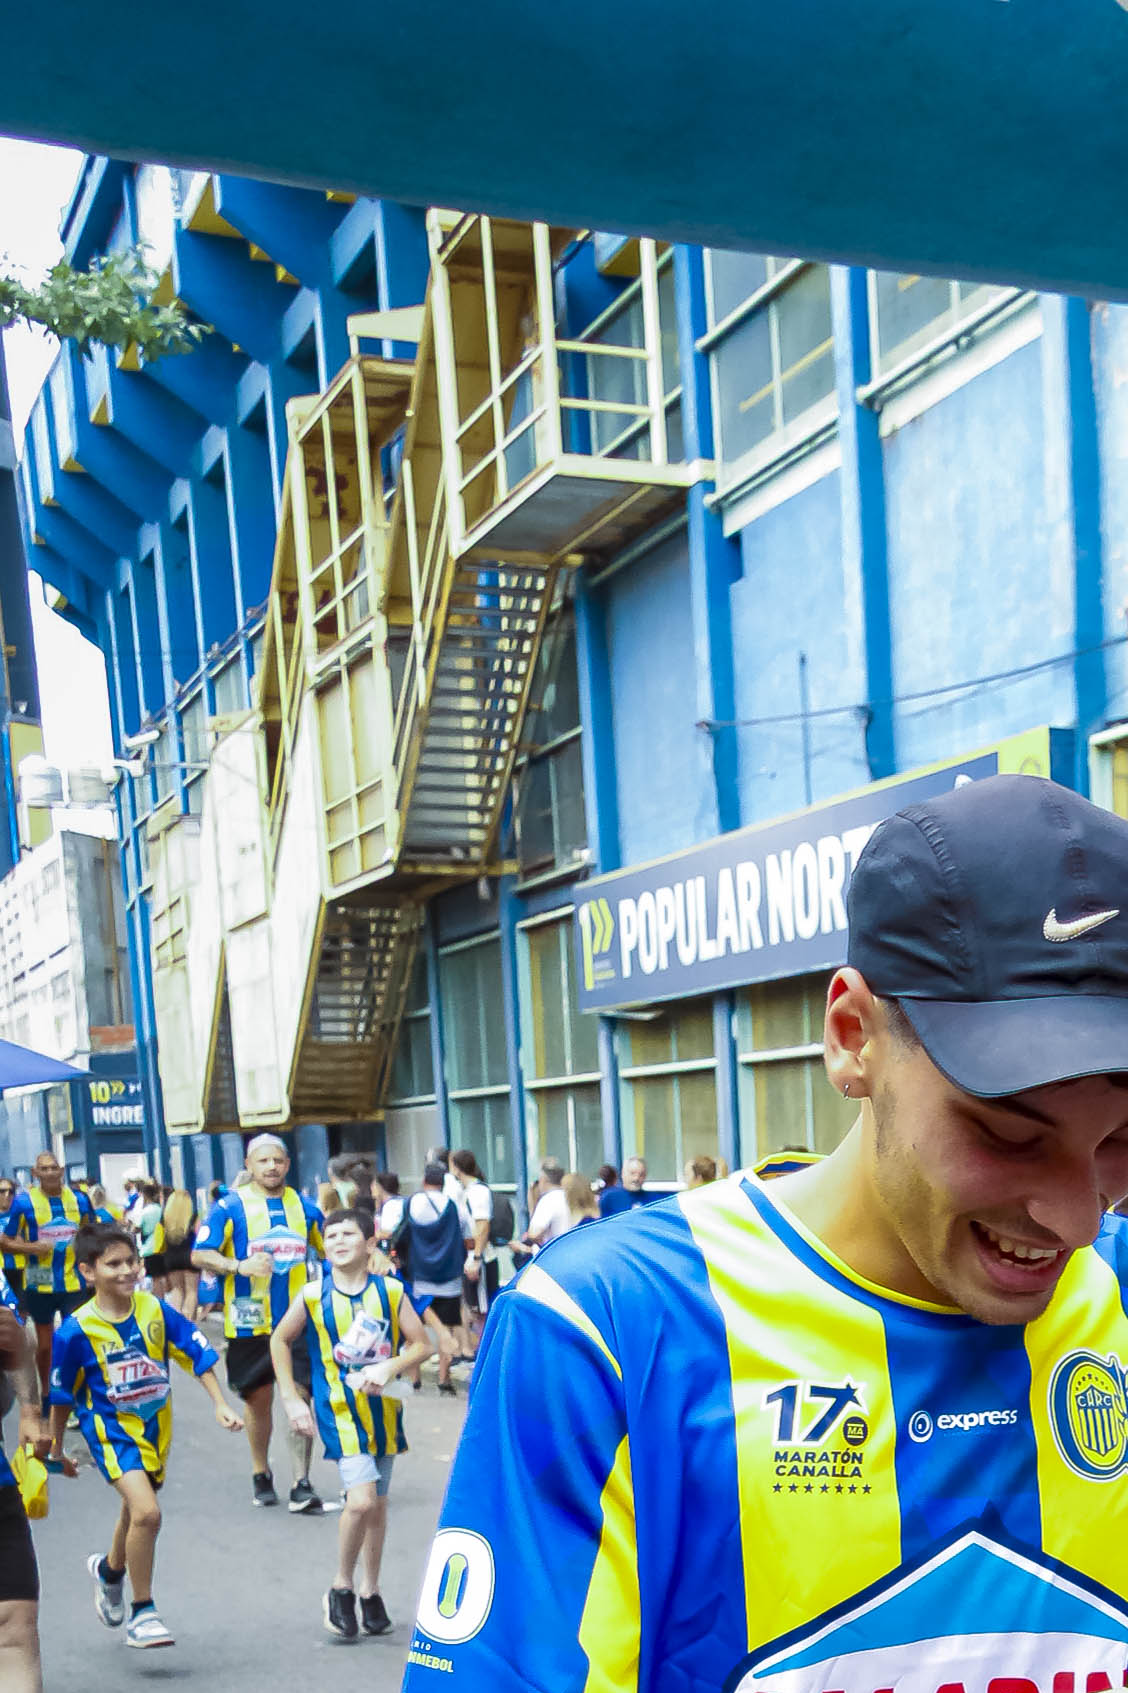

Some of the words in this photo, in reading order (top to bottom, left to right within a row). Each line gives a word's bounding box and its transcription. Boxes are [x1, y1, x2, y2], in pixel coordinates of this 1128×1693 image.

[618, 861, 764, 979] POPULAR
[764, 1379, 865, 1443] 17
[937, 1409, 1018, 1431] express
[774, 1448, 864, 1464] MARATÓN
[775, 1464, 863, 1478] CANALLA
